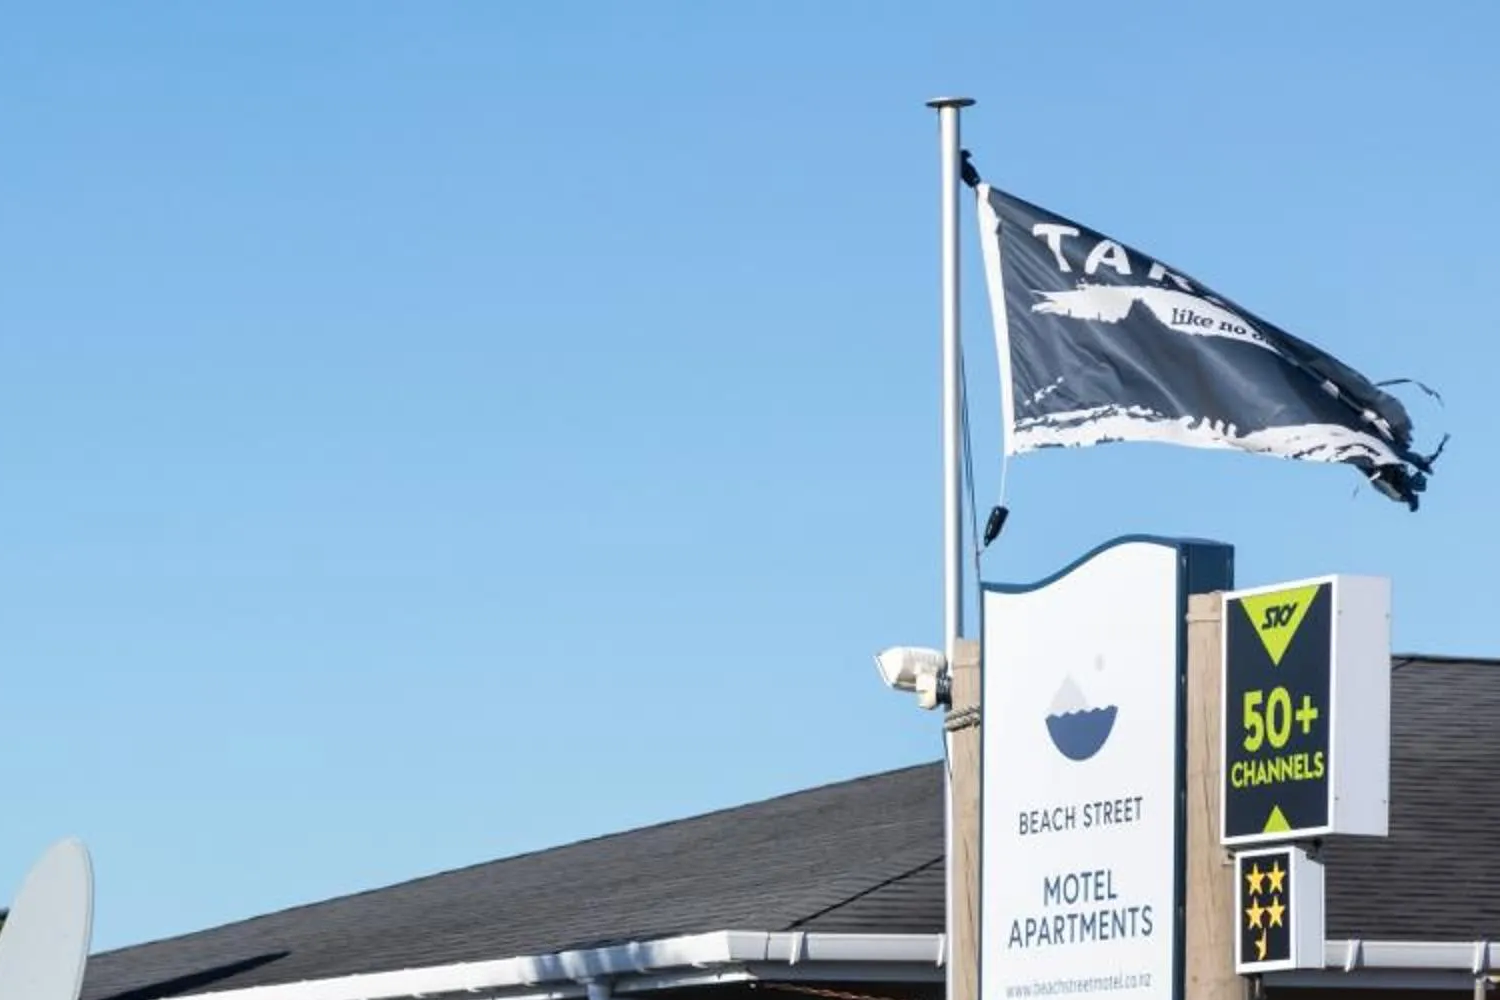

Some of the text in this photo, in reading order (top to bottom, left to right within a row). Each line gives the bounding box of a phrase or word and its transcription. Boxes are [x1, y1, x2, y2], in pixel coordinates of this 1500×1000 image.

[1171, 307, 1247, 336] like no
[1243, 686, 1320, 753] 50+
[1231, 751, 1326, 789] CHANNELS
[1018, 797, 1143, 836] BEACH STREET
[1043, 869, 1118, 906] MOTEL
[1008, 906, 1154, 949] APARTMENTS
